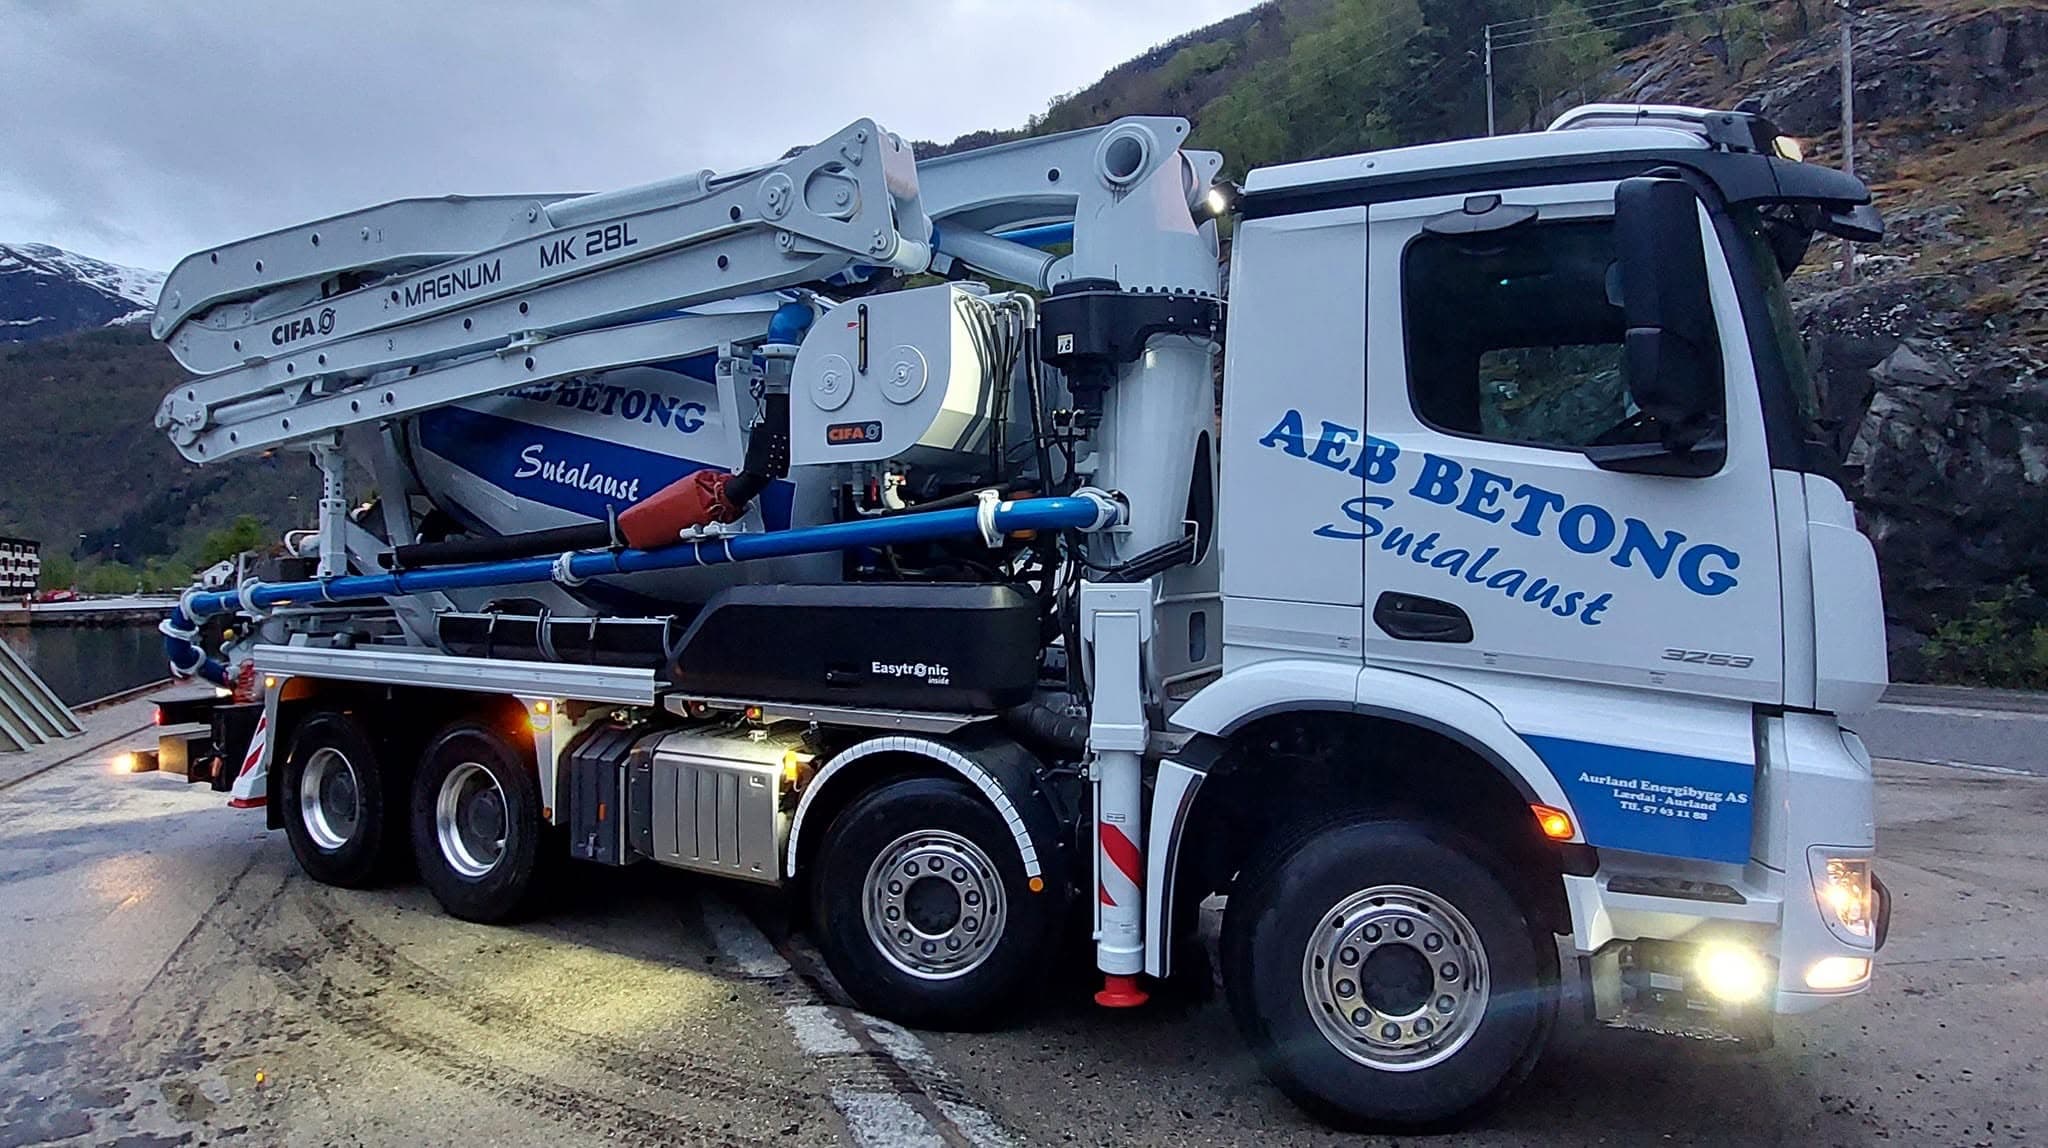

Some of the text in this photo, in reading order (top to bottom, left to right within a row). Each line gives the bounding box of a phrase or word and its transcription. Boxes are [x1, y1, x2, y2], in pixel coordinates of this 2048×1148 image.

[405, 221, 638, 308] MAGNUM MK 28L
[271, 324, 316, 346] CIFA
[829, 427, 864, 441] CIFA
[515, 445, 638, 501] Sutalaust
[1258, 409, 1742, 597] AEB BETONG
[1313, 497, 1613, 627] Sutalaust
[872, 661, 949, 677] Easytronic
[1660, 648, 1755, 669] 3253
[927, 676, 950, 685] inside
[1578, 771, 1749, 804] Aurland Energibygg AS
[1613, 788, 1656, 803] Lærdal
[1664, 796, 1718, 812] Aurland
[1643, 806, 1657, 815] 57
[1692, 812, 1708, 821] 88
